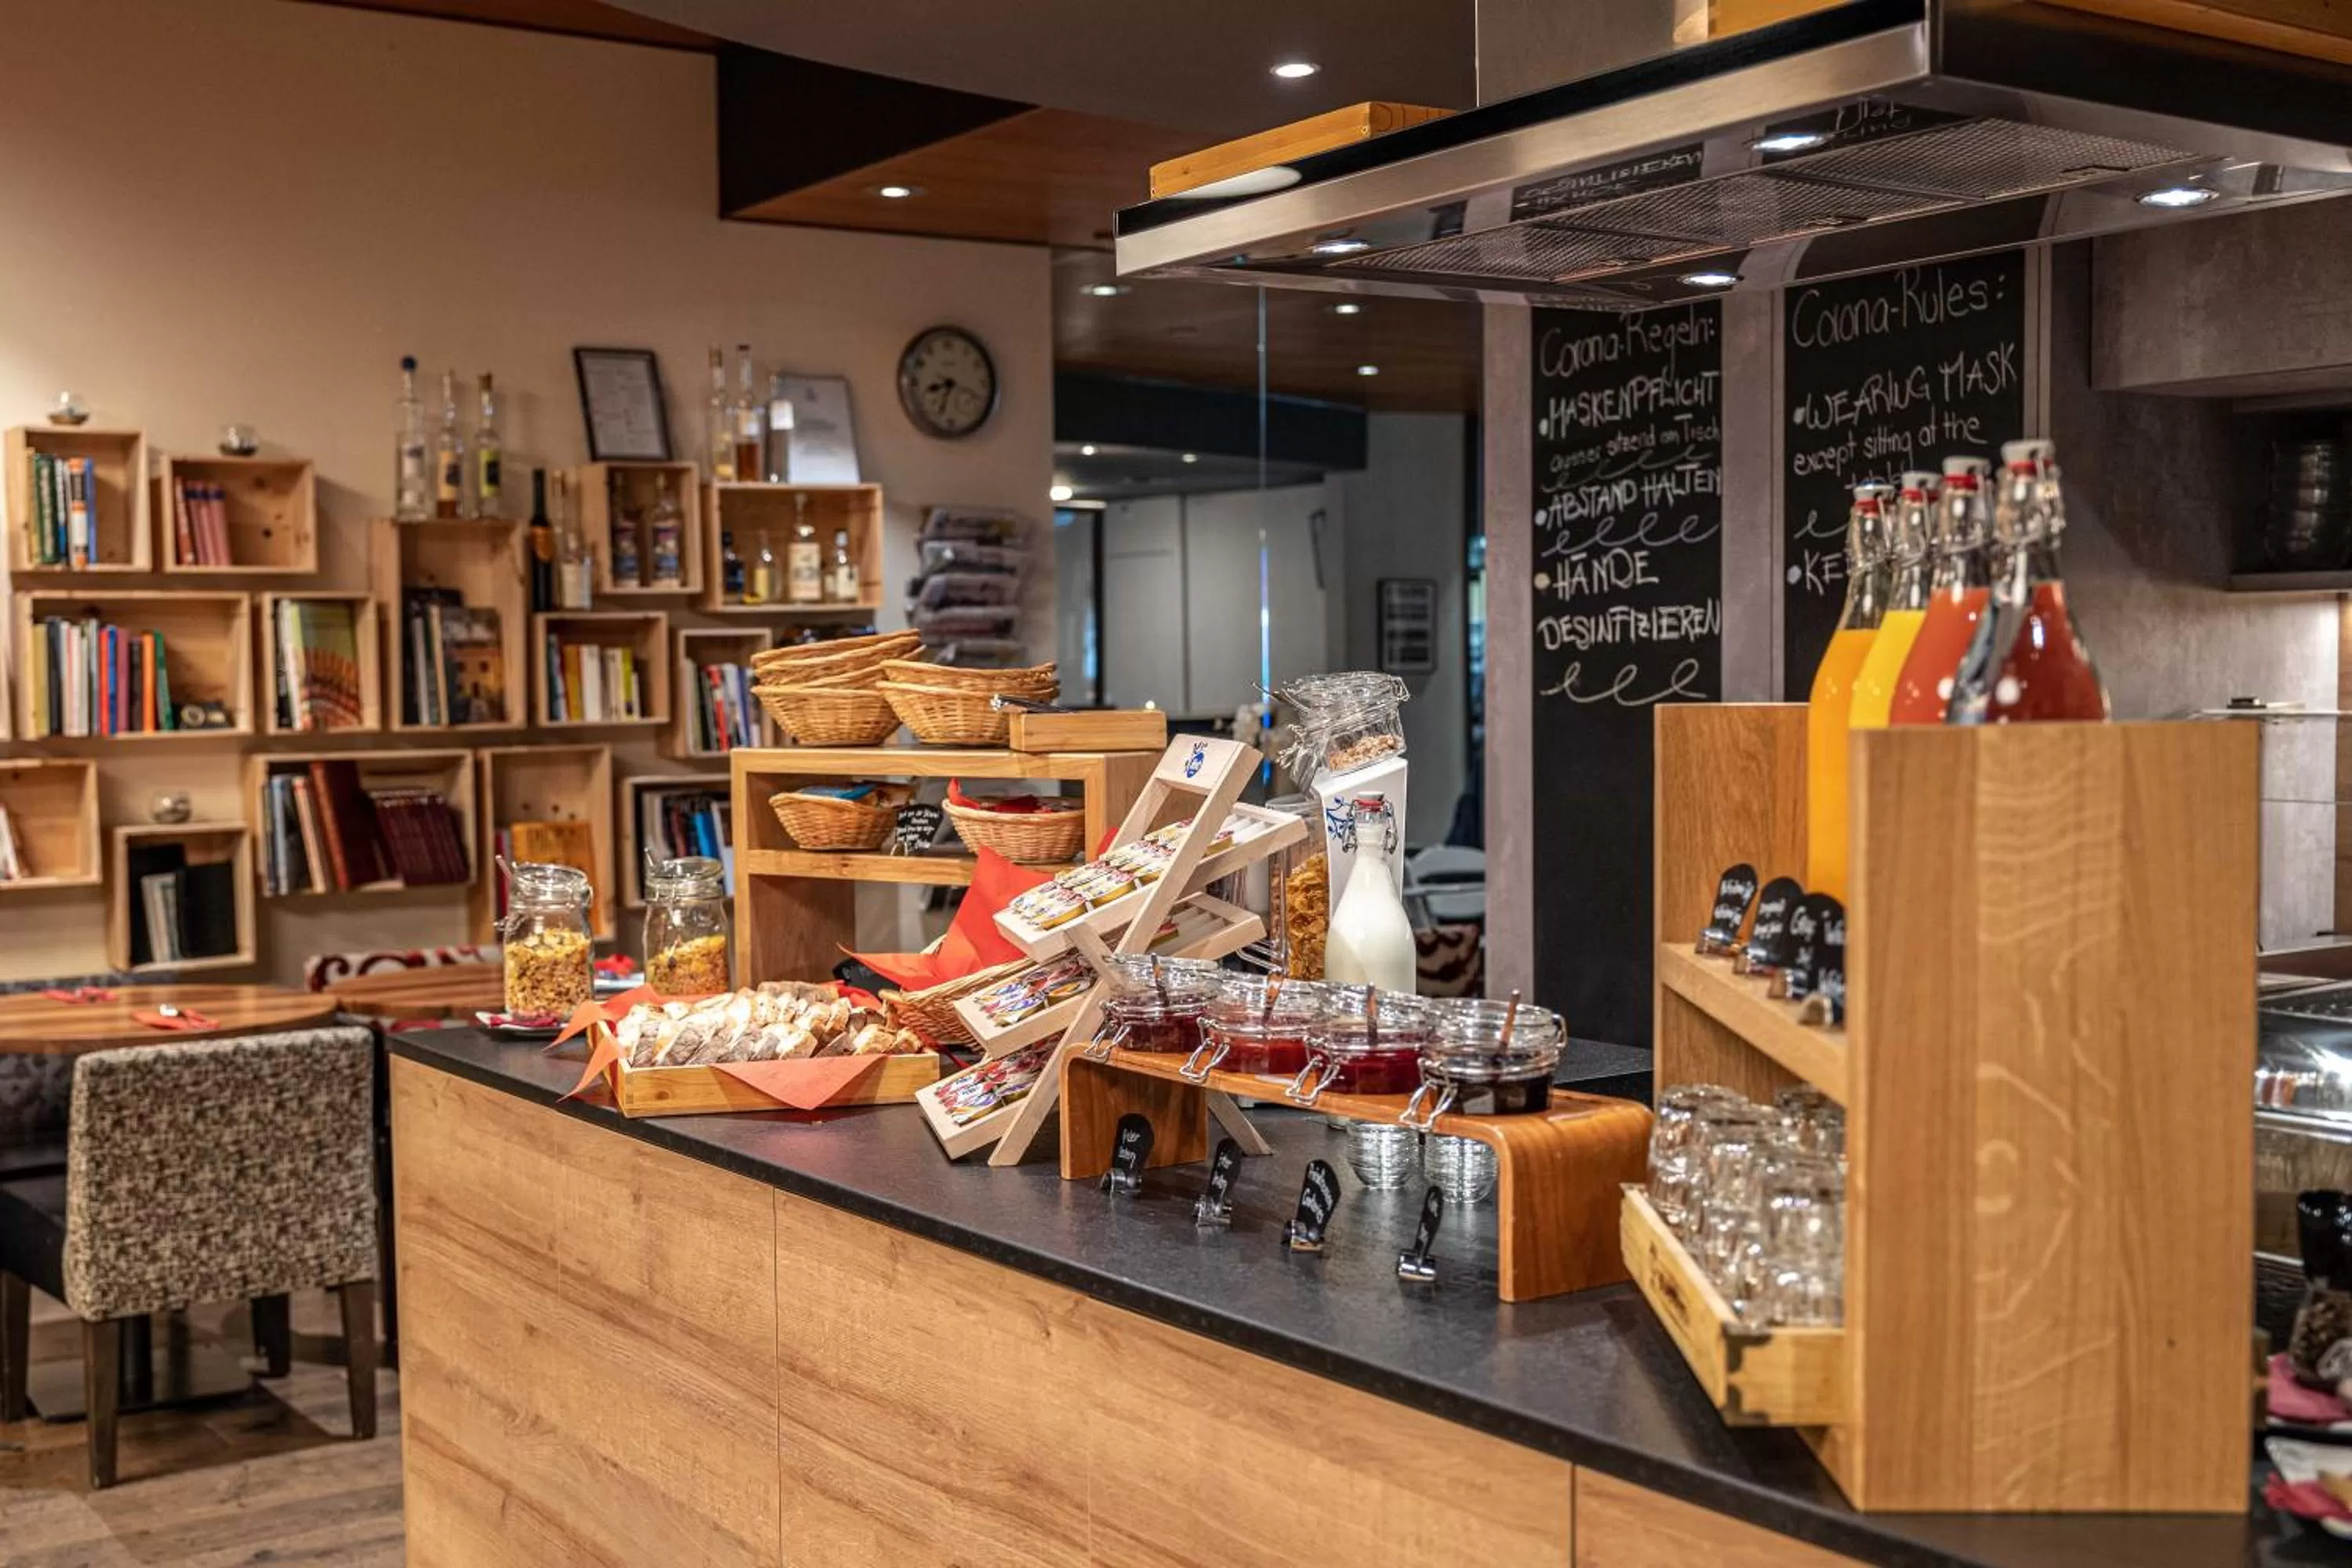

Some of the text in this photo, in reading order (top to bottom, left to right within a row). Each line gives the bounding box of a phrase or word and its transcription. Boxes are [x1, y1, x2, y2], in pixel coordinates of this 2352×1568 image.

[1792, 266, 2005, 347] Corona-Rules:
[1938, 342, 2018, 402] MASK
[1793, 404, 1988, 477] except sitting at the
[1546, 463, 1722, 531] ABSTAND HALTEN
[1804, 548, 1849, 596] KE
[1537, 597, 1721, 650] DESINFIZIEREN
